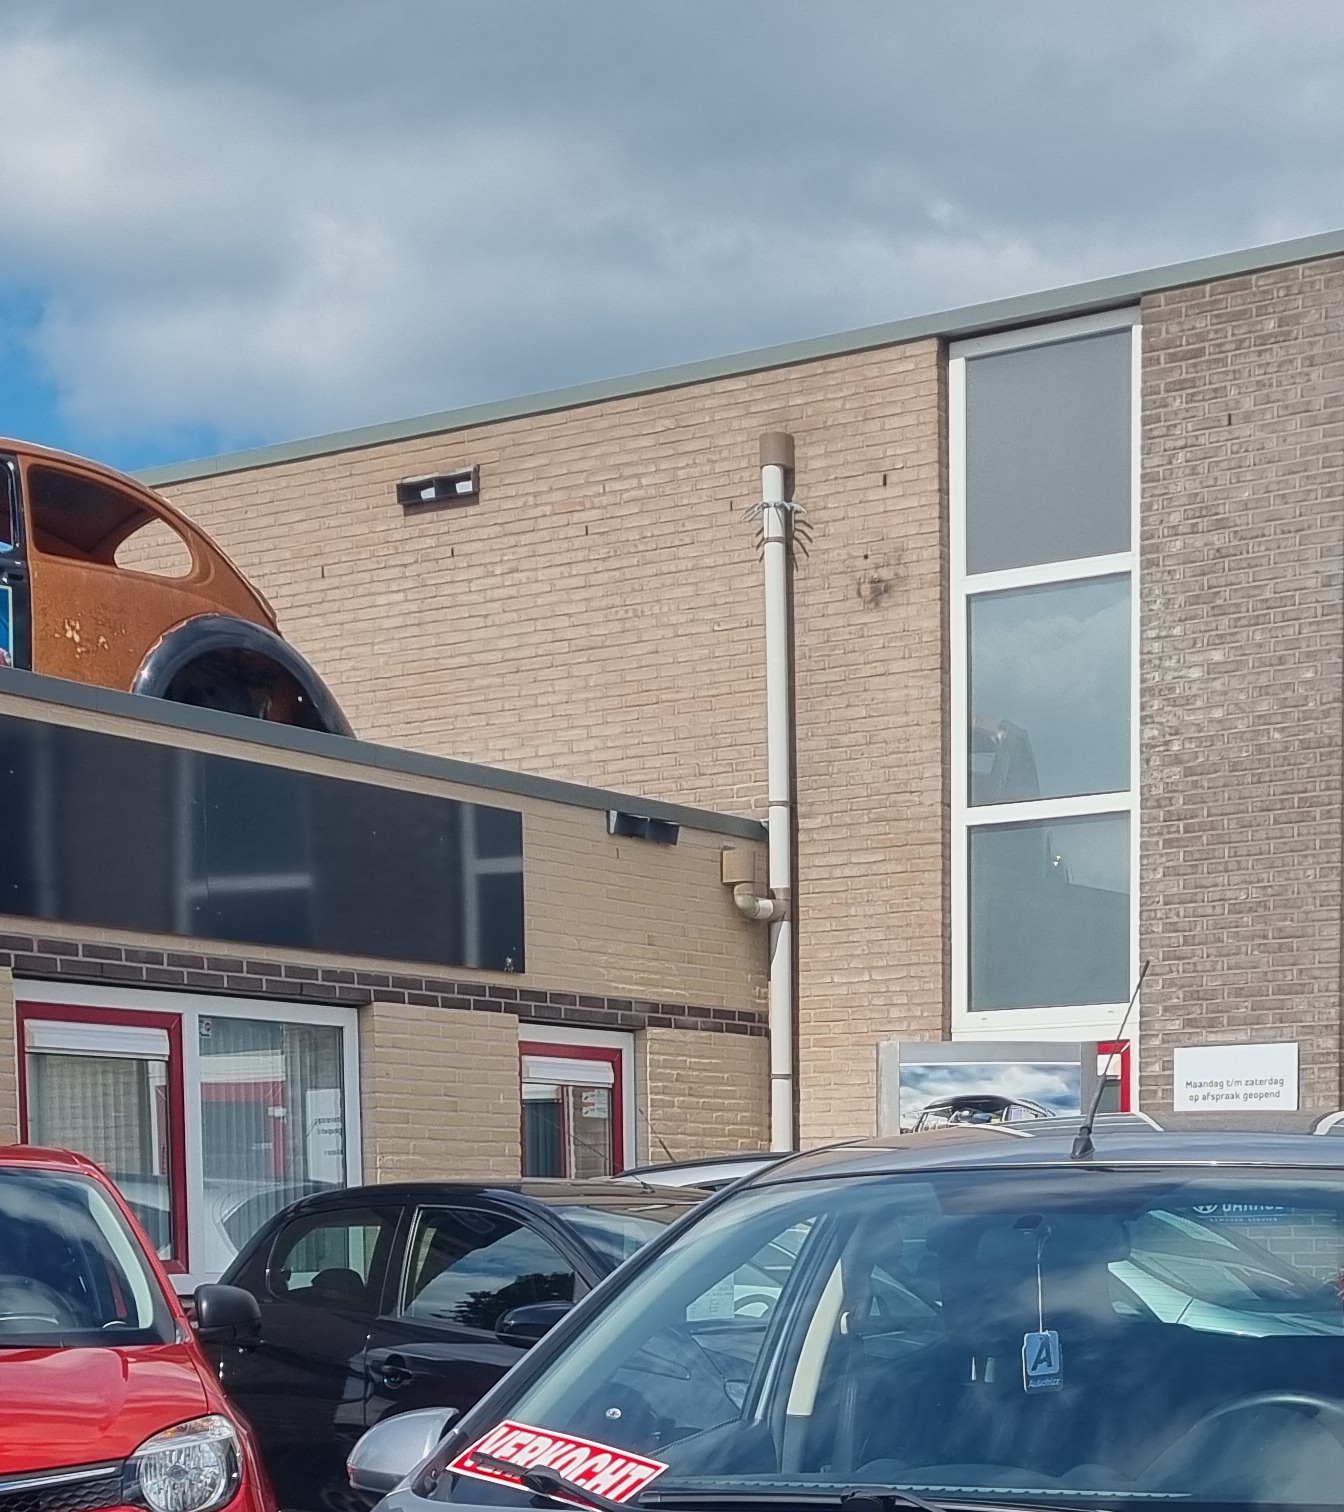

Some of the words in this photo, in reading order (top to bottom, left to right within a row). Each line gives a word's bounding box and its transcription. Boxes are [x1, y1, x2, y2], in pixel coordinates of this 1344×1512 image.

[1185, 1080, 1224, 1089] Maandag
[1226, 1078, 1242, 1087] t/m
[1244, 1077, 1284, 1087] zaterdag
[1189, 1094, 1199, 1103] op
[1201, 1091, 1240, 1102] afspraak
[1242, 1090, 1280, 1101] geopend
